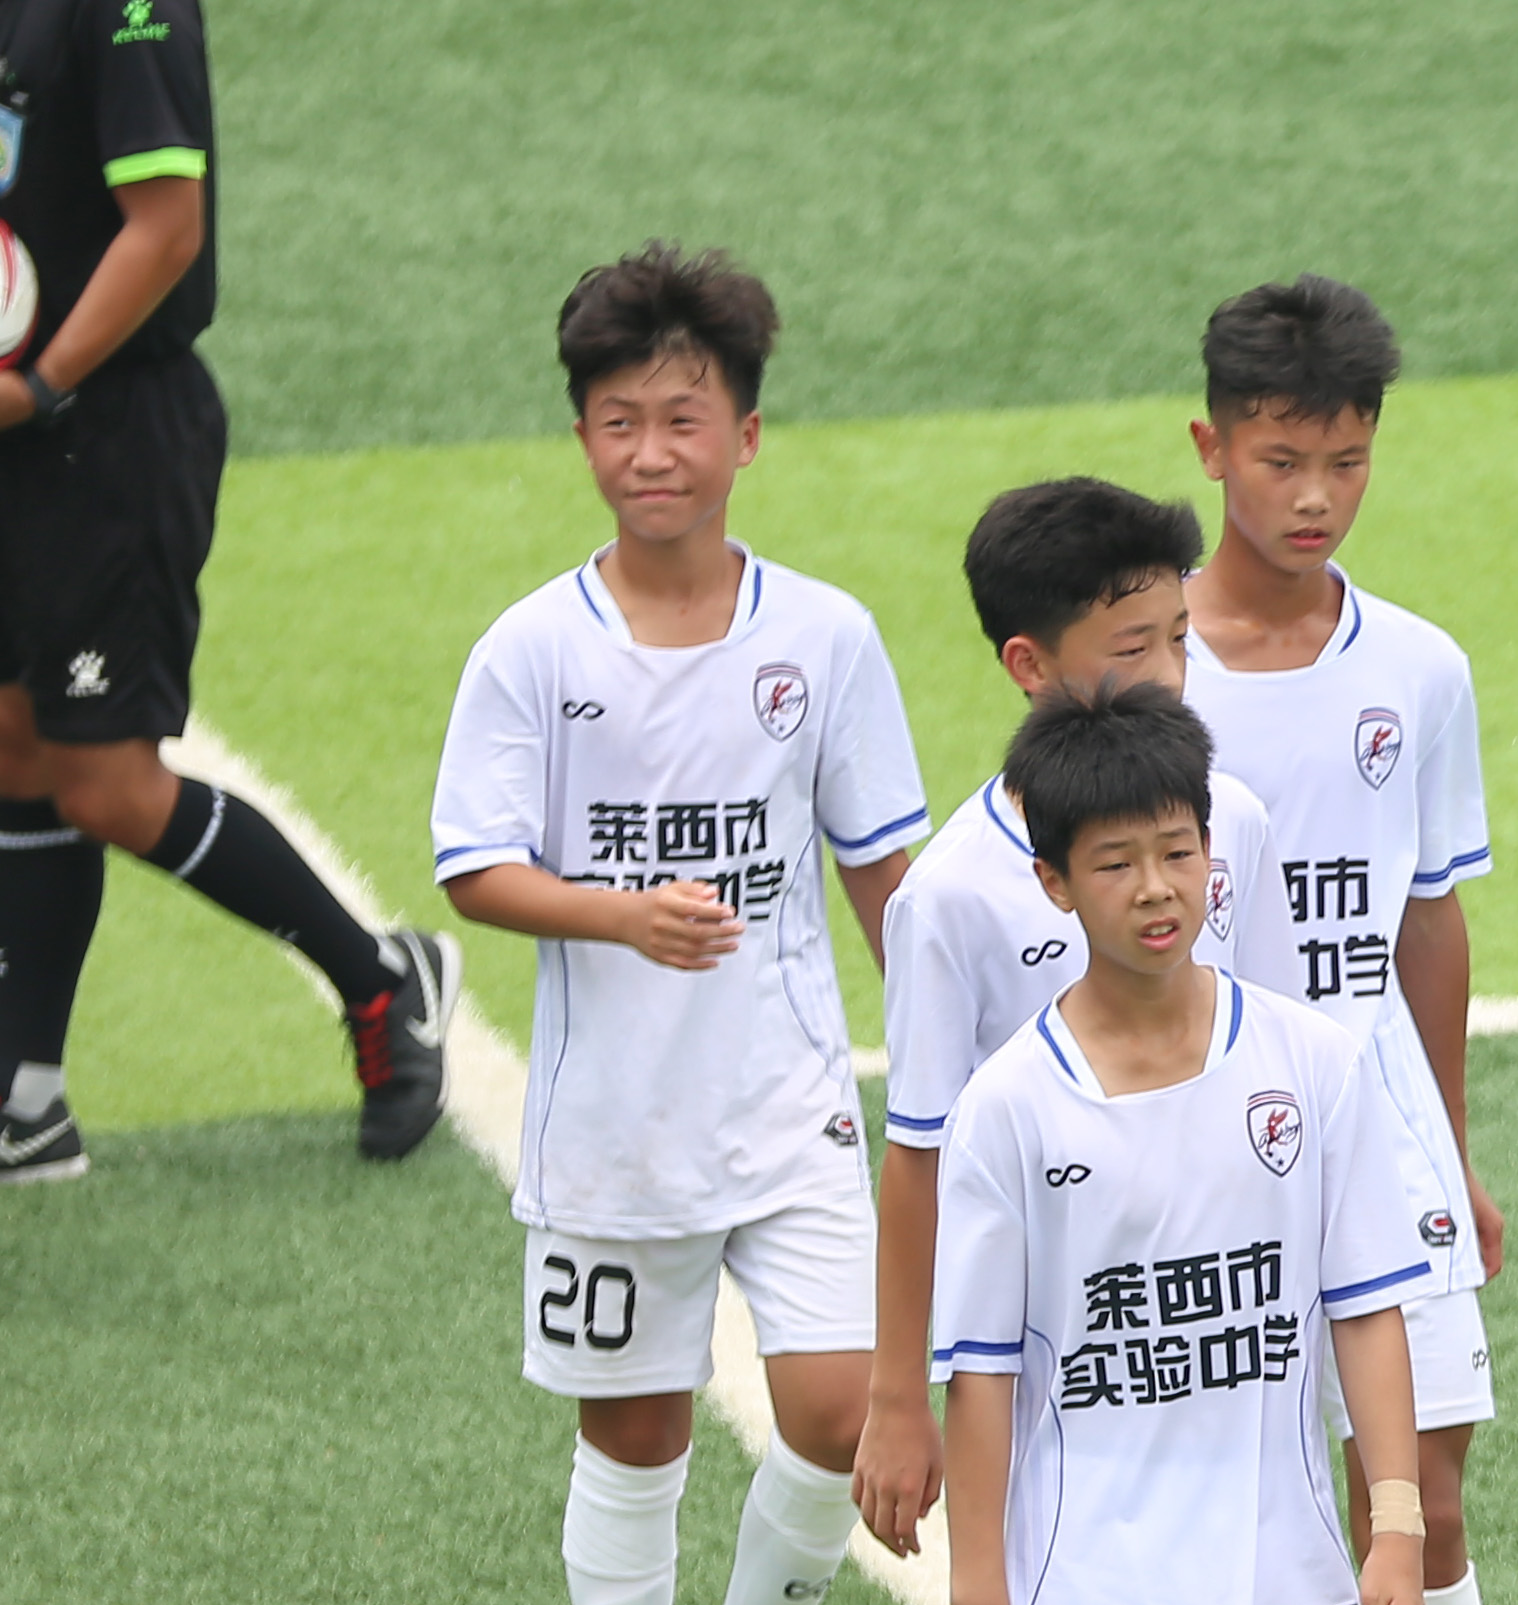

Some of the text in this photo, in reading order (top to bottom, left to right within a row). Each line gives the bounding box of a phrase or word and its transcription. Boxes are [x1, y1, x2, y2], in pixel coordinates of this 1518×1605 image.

[588, 797, 770, 865] 莱西市
[540, 1255, 636, 1350] 20
[1083, 1240, 1283, 1333] 莱西市
[1059, 1312, 1300, 1411] 实验中学
